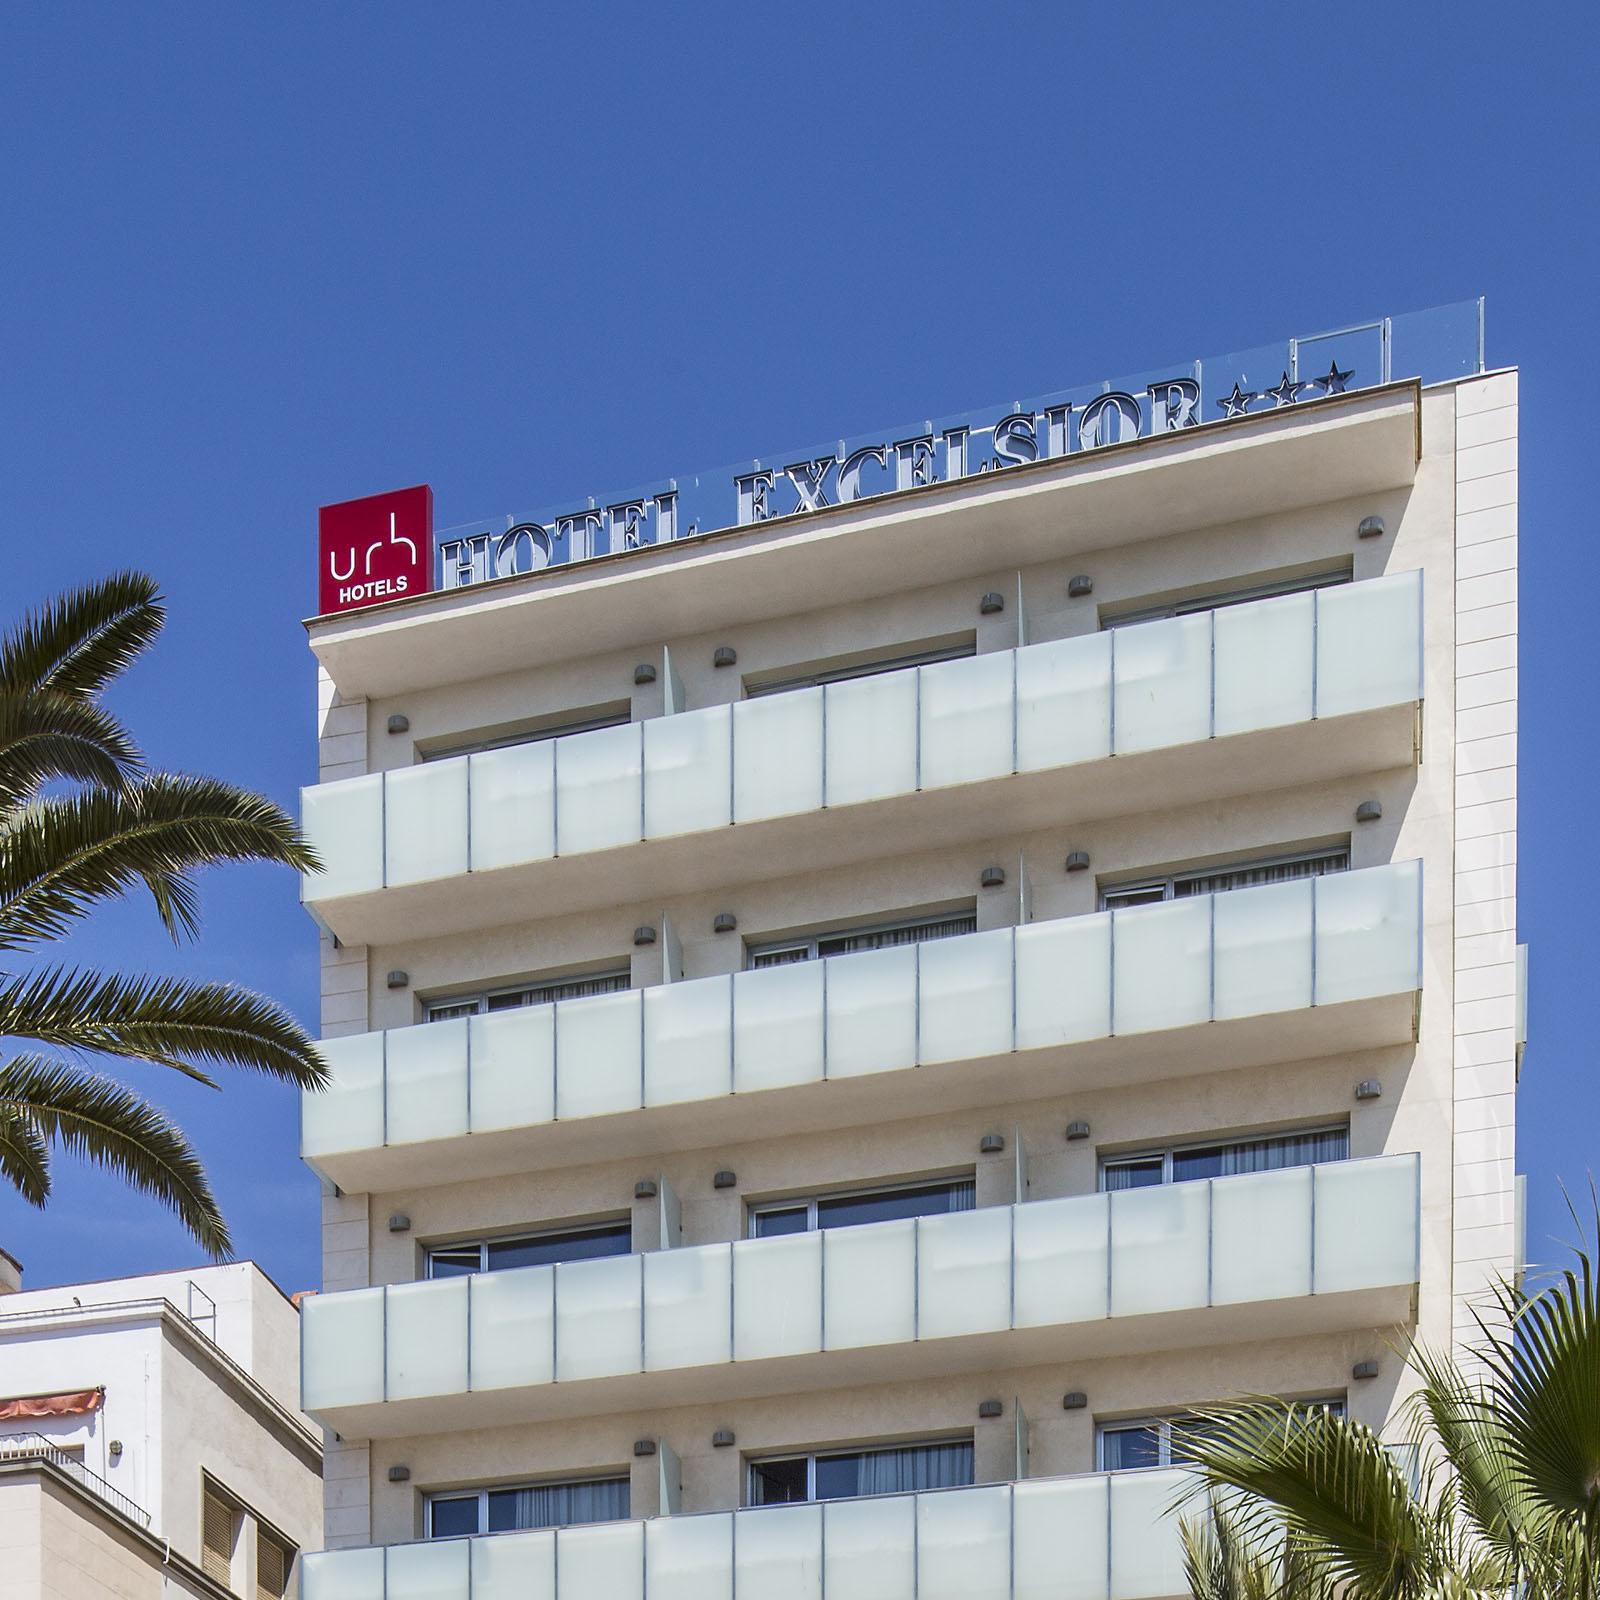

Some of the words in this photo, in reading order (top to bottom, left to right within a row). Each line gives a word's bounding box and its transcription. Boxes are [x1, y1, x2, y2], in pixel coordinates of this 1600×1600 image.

[439, 489, 698, 590] HOTEL
[733, 376, 1200, 528] EXCELSIOR
[330, 511, 417, 581] urh
[338, 575, 408, 604] HOTELS
